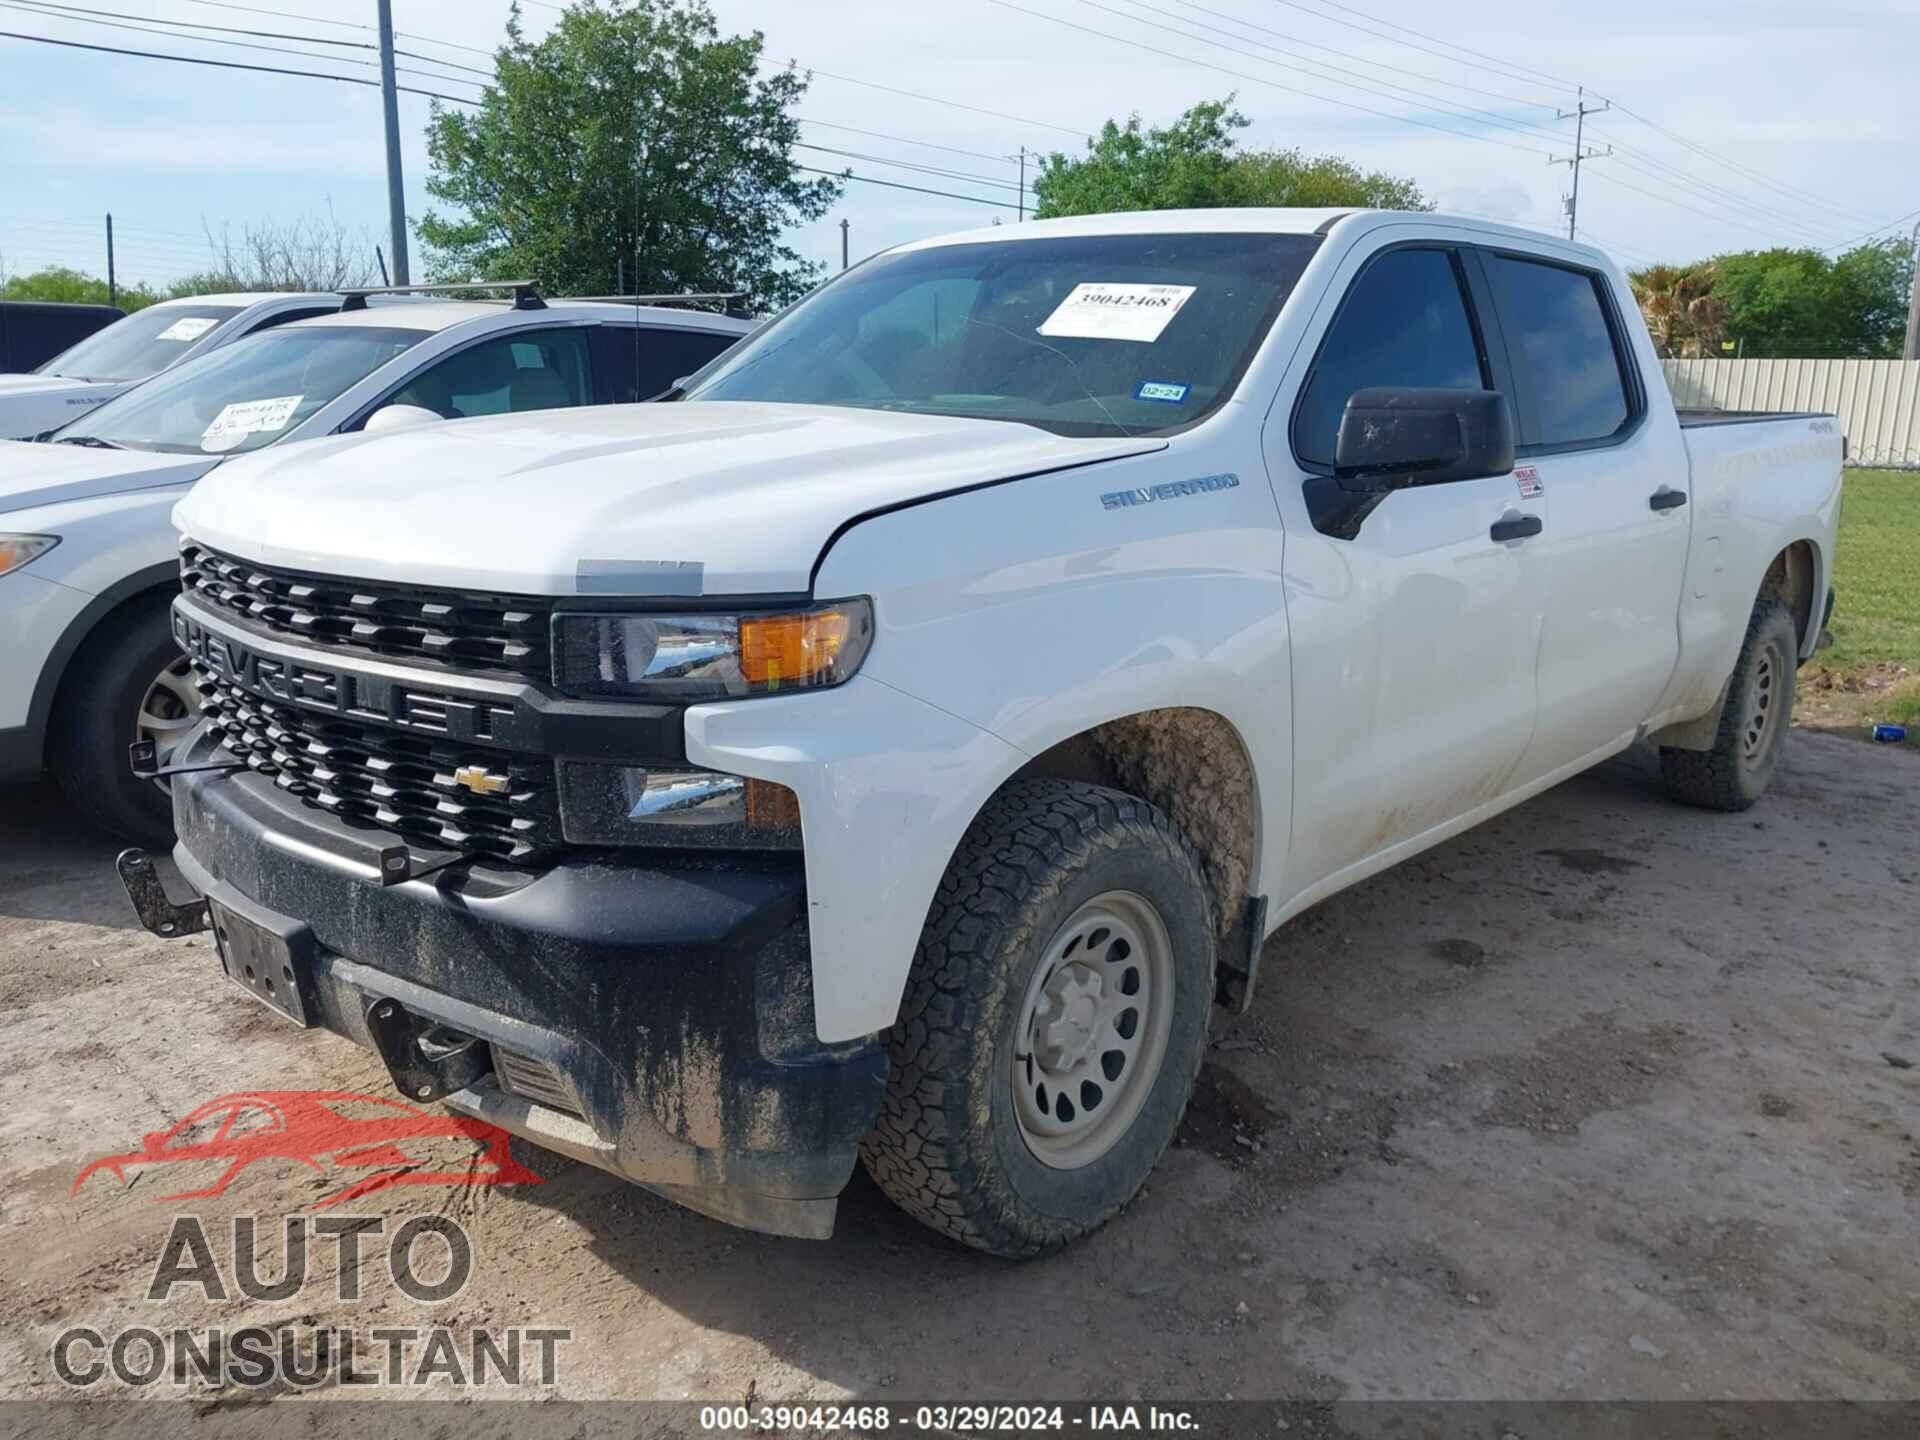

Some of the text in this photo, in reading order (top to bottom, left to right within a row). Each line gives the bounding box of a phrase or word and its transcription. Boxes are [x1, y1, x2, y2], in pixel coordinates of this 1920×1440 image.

[1081, 293, 1171, 308] 39042468
[1100, 473, 1240, 510] SILVERADO
[173, 613, 516, 742] CHEVROLET
